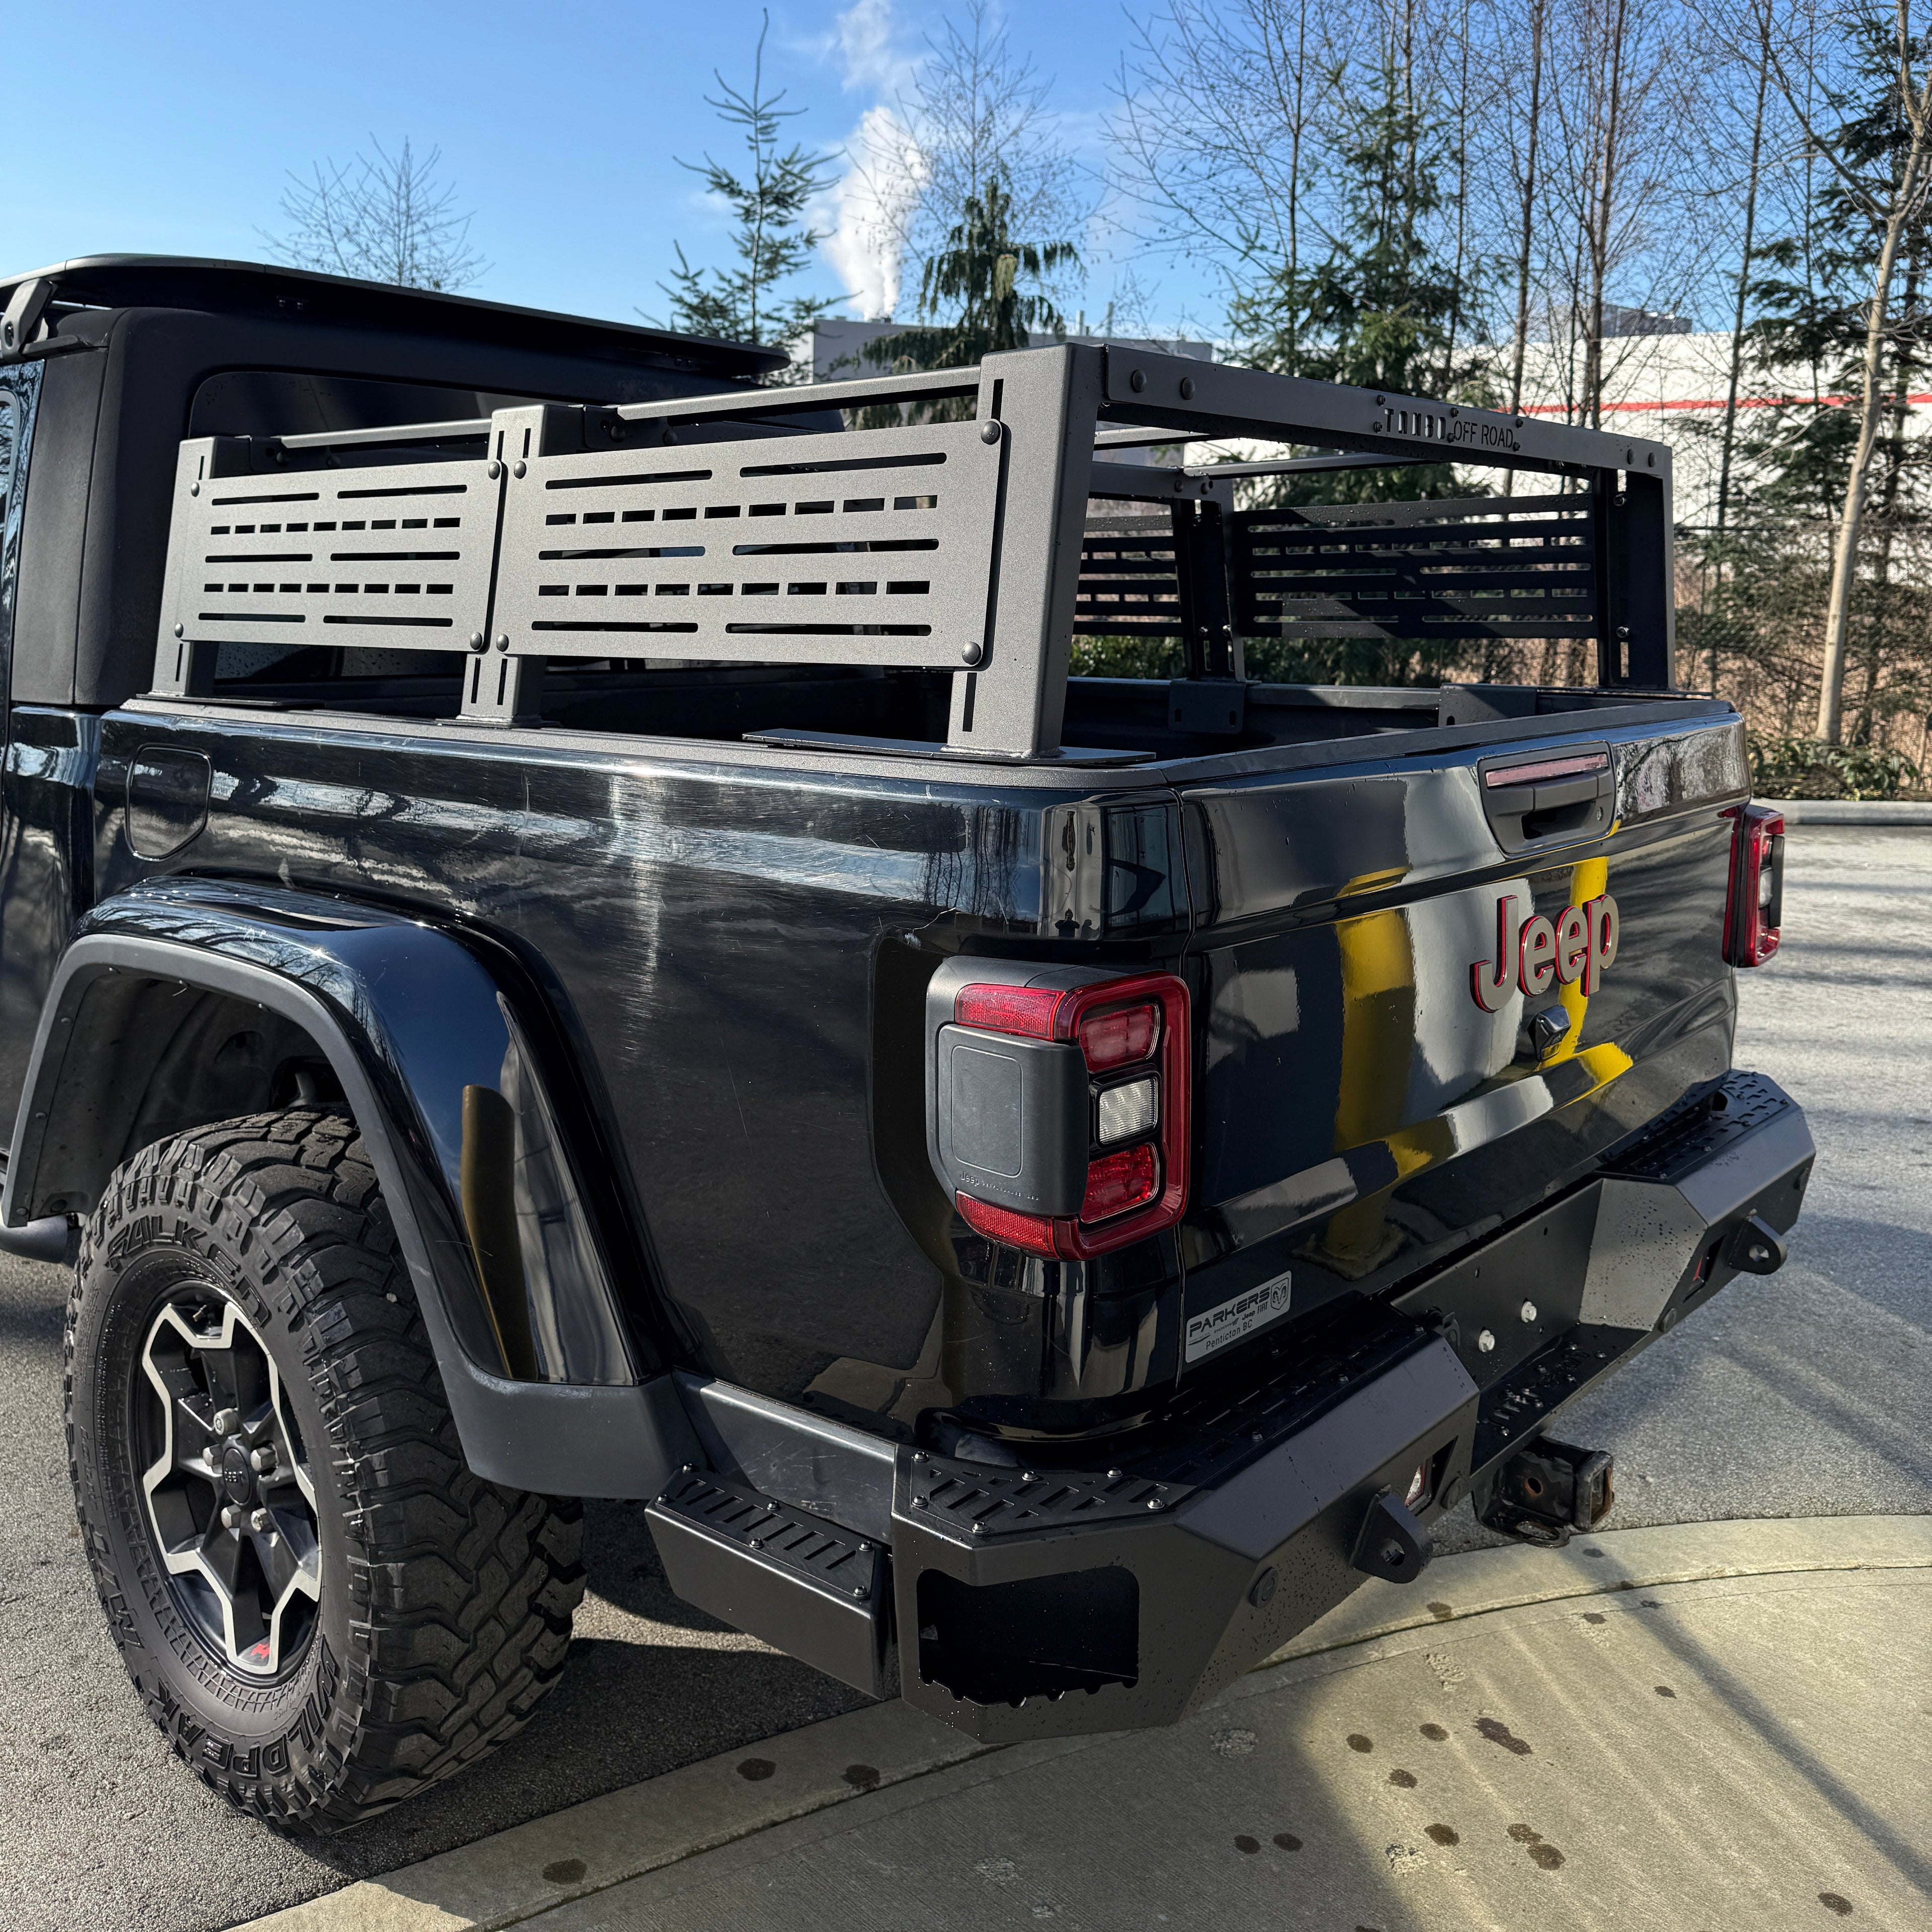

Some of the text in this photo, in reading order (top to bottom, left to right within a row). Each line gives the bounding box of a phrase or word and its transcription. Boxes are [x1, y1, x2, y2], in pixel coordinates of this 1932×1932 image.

[1454, 420, 1478, 443] OFF
[1481, 424, 1513, 448] ROAD
[1469, 894, 1619, 1013] Jeep
[960, 1171, 980, 1187] Jeep
[105, 1215, 272, 1329] FALKEN
[1189, 1286, 1270, 1337] PARKERS
[1242, 1310, 1255, 1321] Jeep
[1257, 1301, 1268, 1314] FIAT
[1206, 1326, 1240, 1350] Penticton
[1243, 1319, 1252, 1331] BC
[149, 1634, 340, 1778] WILDPEAK
